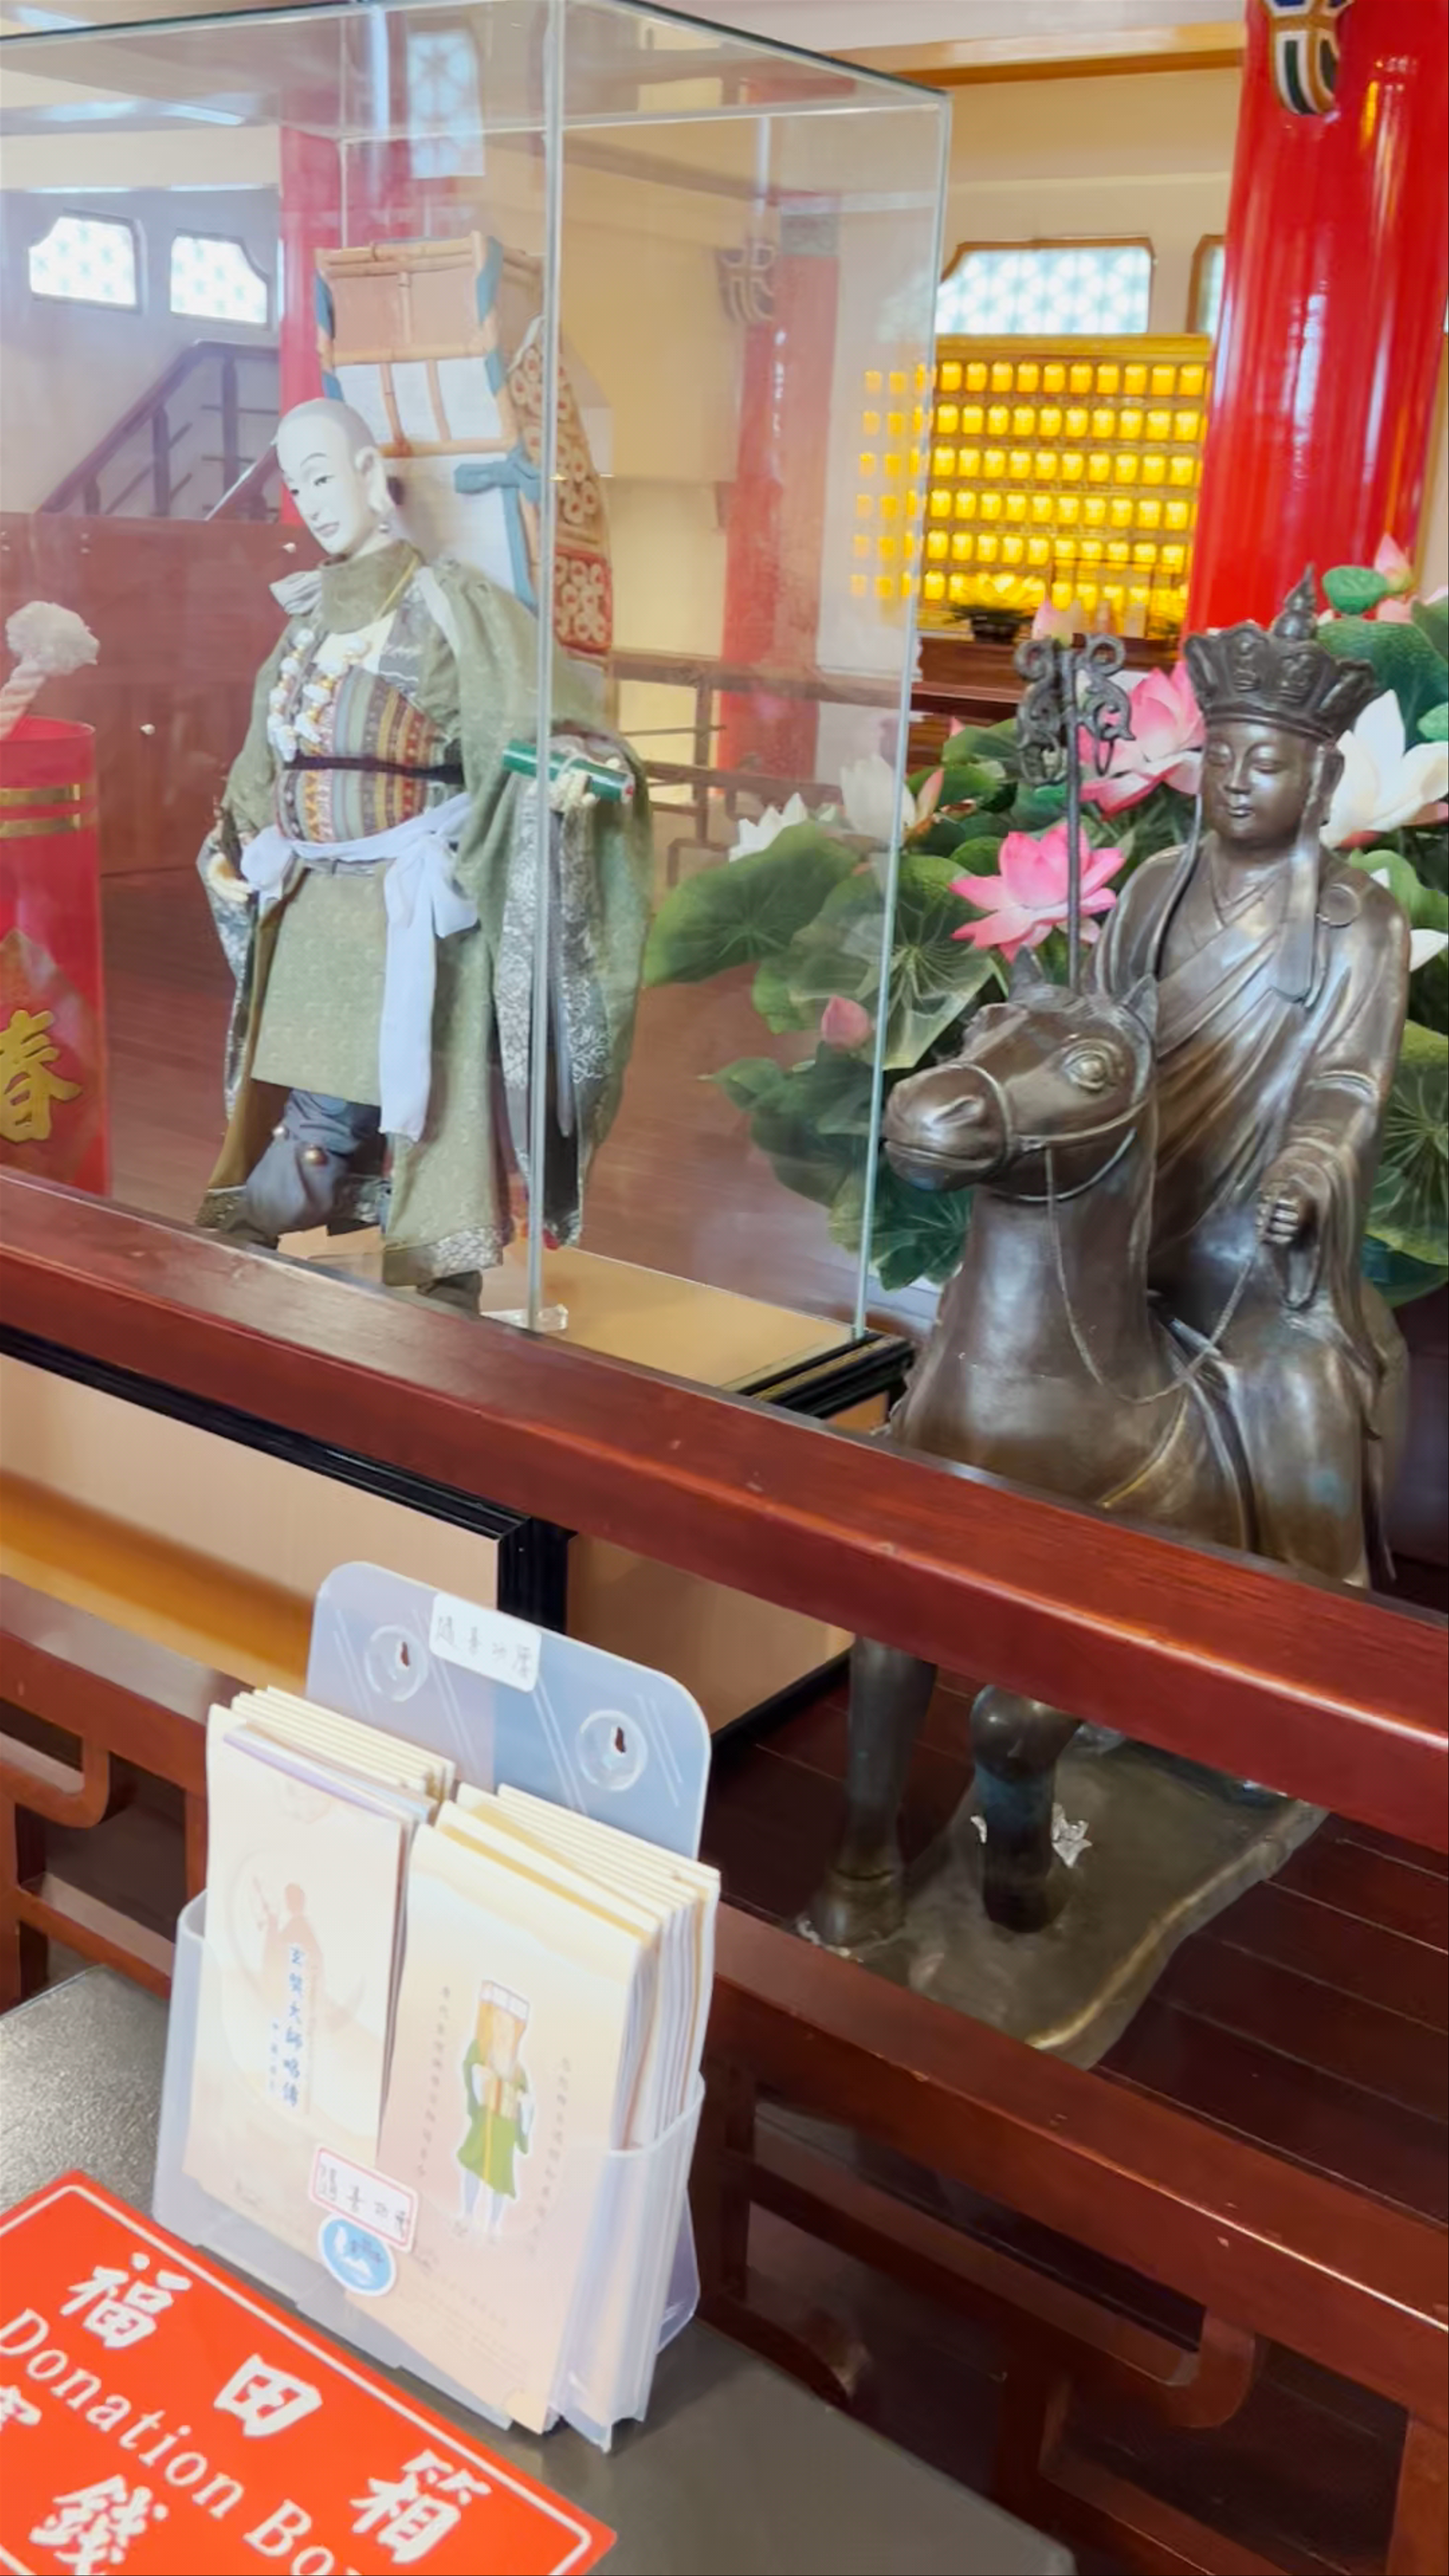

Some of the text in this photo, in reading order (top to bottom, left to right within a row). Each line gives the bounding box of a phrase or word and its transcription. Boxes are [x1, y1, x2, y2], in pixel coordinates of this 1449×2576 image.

[0, 1009, 82, 1143] 春
[0, 2308, 245, 2520] Donation
[242, 2498, 363, 2576] Bo
[59, 2253, 492, 2564] 福田箱
